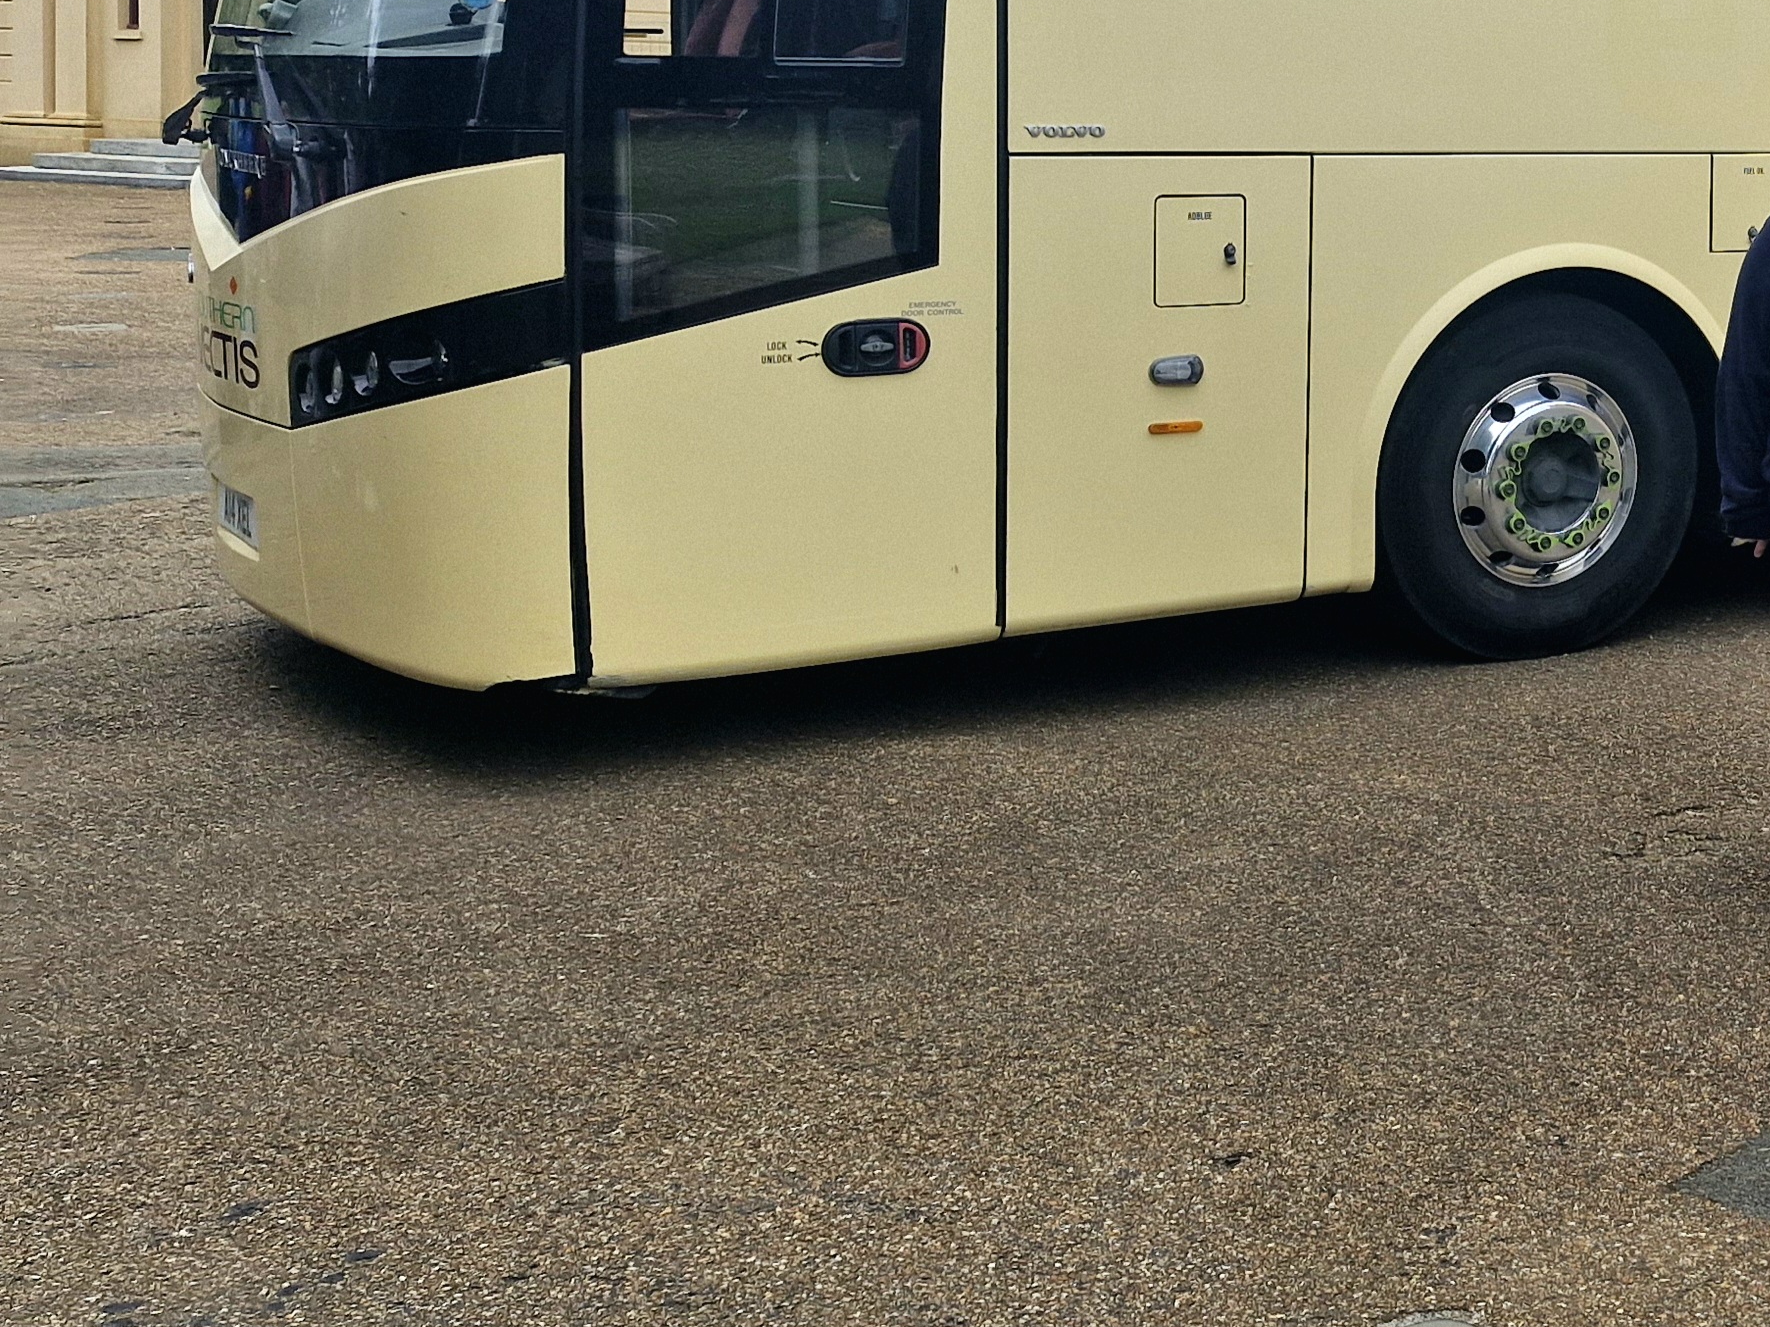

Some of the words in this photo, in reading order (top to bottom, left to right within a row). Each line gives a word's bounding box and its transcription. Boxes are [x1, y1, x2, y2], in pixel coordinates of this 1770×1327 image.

[1023, 124, 1106, 138] VOLVO
[908, 300, 957, 309] EMERGENCY
[901, 309, 924, 317] DOOR
[926, 308, 964, 316] CONTROL
[766, 341, 787, 351] LOCK
[761, 354, 793, 364] UNLOCK
